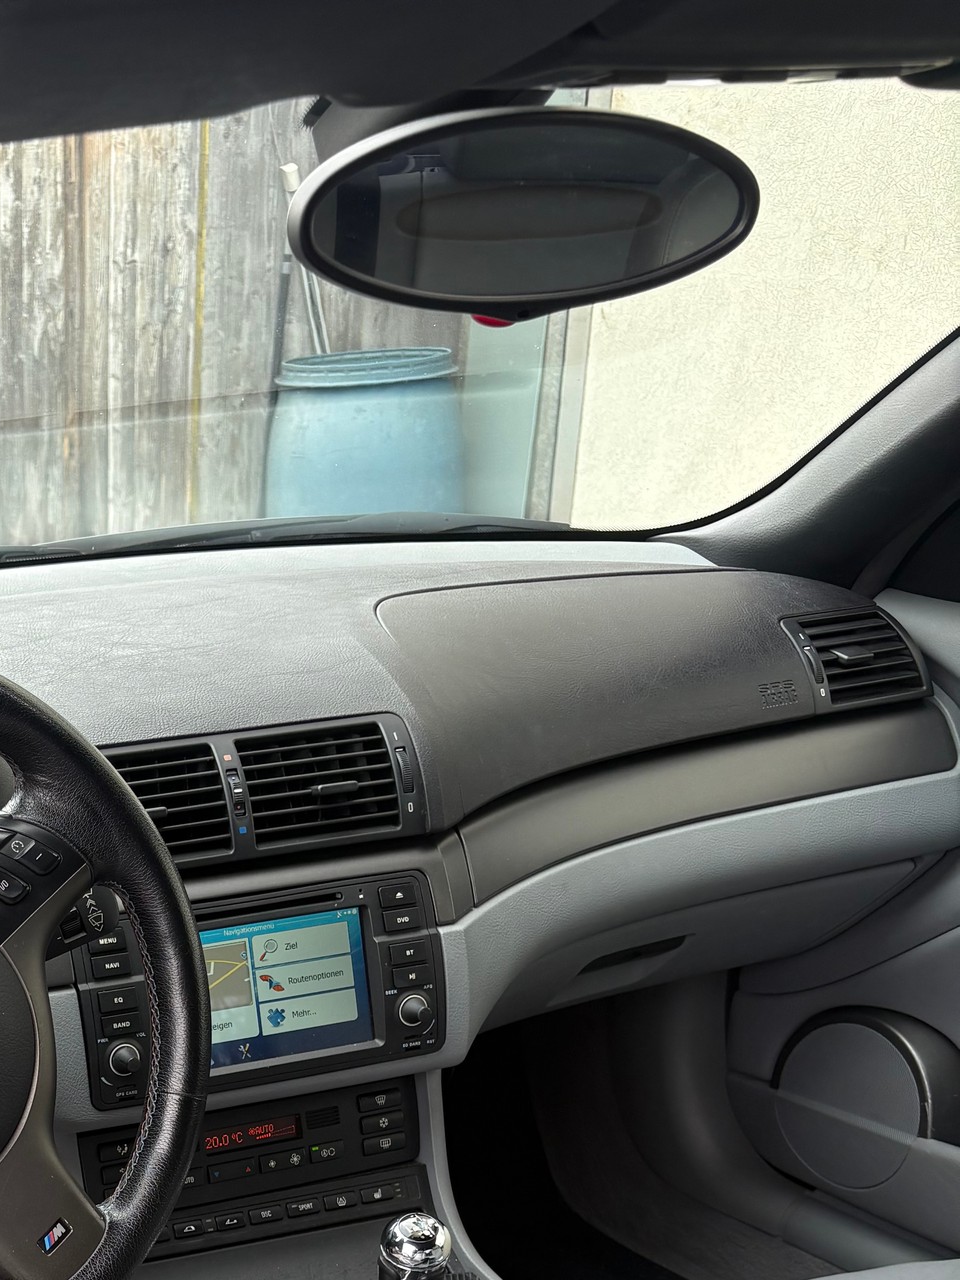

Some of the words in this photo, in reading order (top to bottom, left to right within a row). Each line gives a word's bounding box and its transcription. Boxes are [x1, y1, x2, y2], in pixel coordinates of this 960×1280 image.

[396, 916, 410, 924] DVD
[223, 923, 275, 937] Navigationsmenu
[99, 937, 117, 945] MENU
[284, 941, 298, 951] Ziel
[288, 969, 344, 985] Routenoptionen
[113, 1021, 131, 1029] BAND
[212, 1021, 233, 1031] eigen
[205, 1134, 230, 1150] 20.0
[255, 1123, 275, 1135] AUTO
[298, 1202, 313, 1211] SPORT
[260, 1210, 272, 1218] DSC
